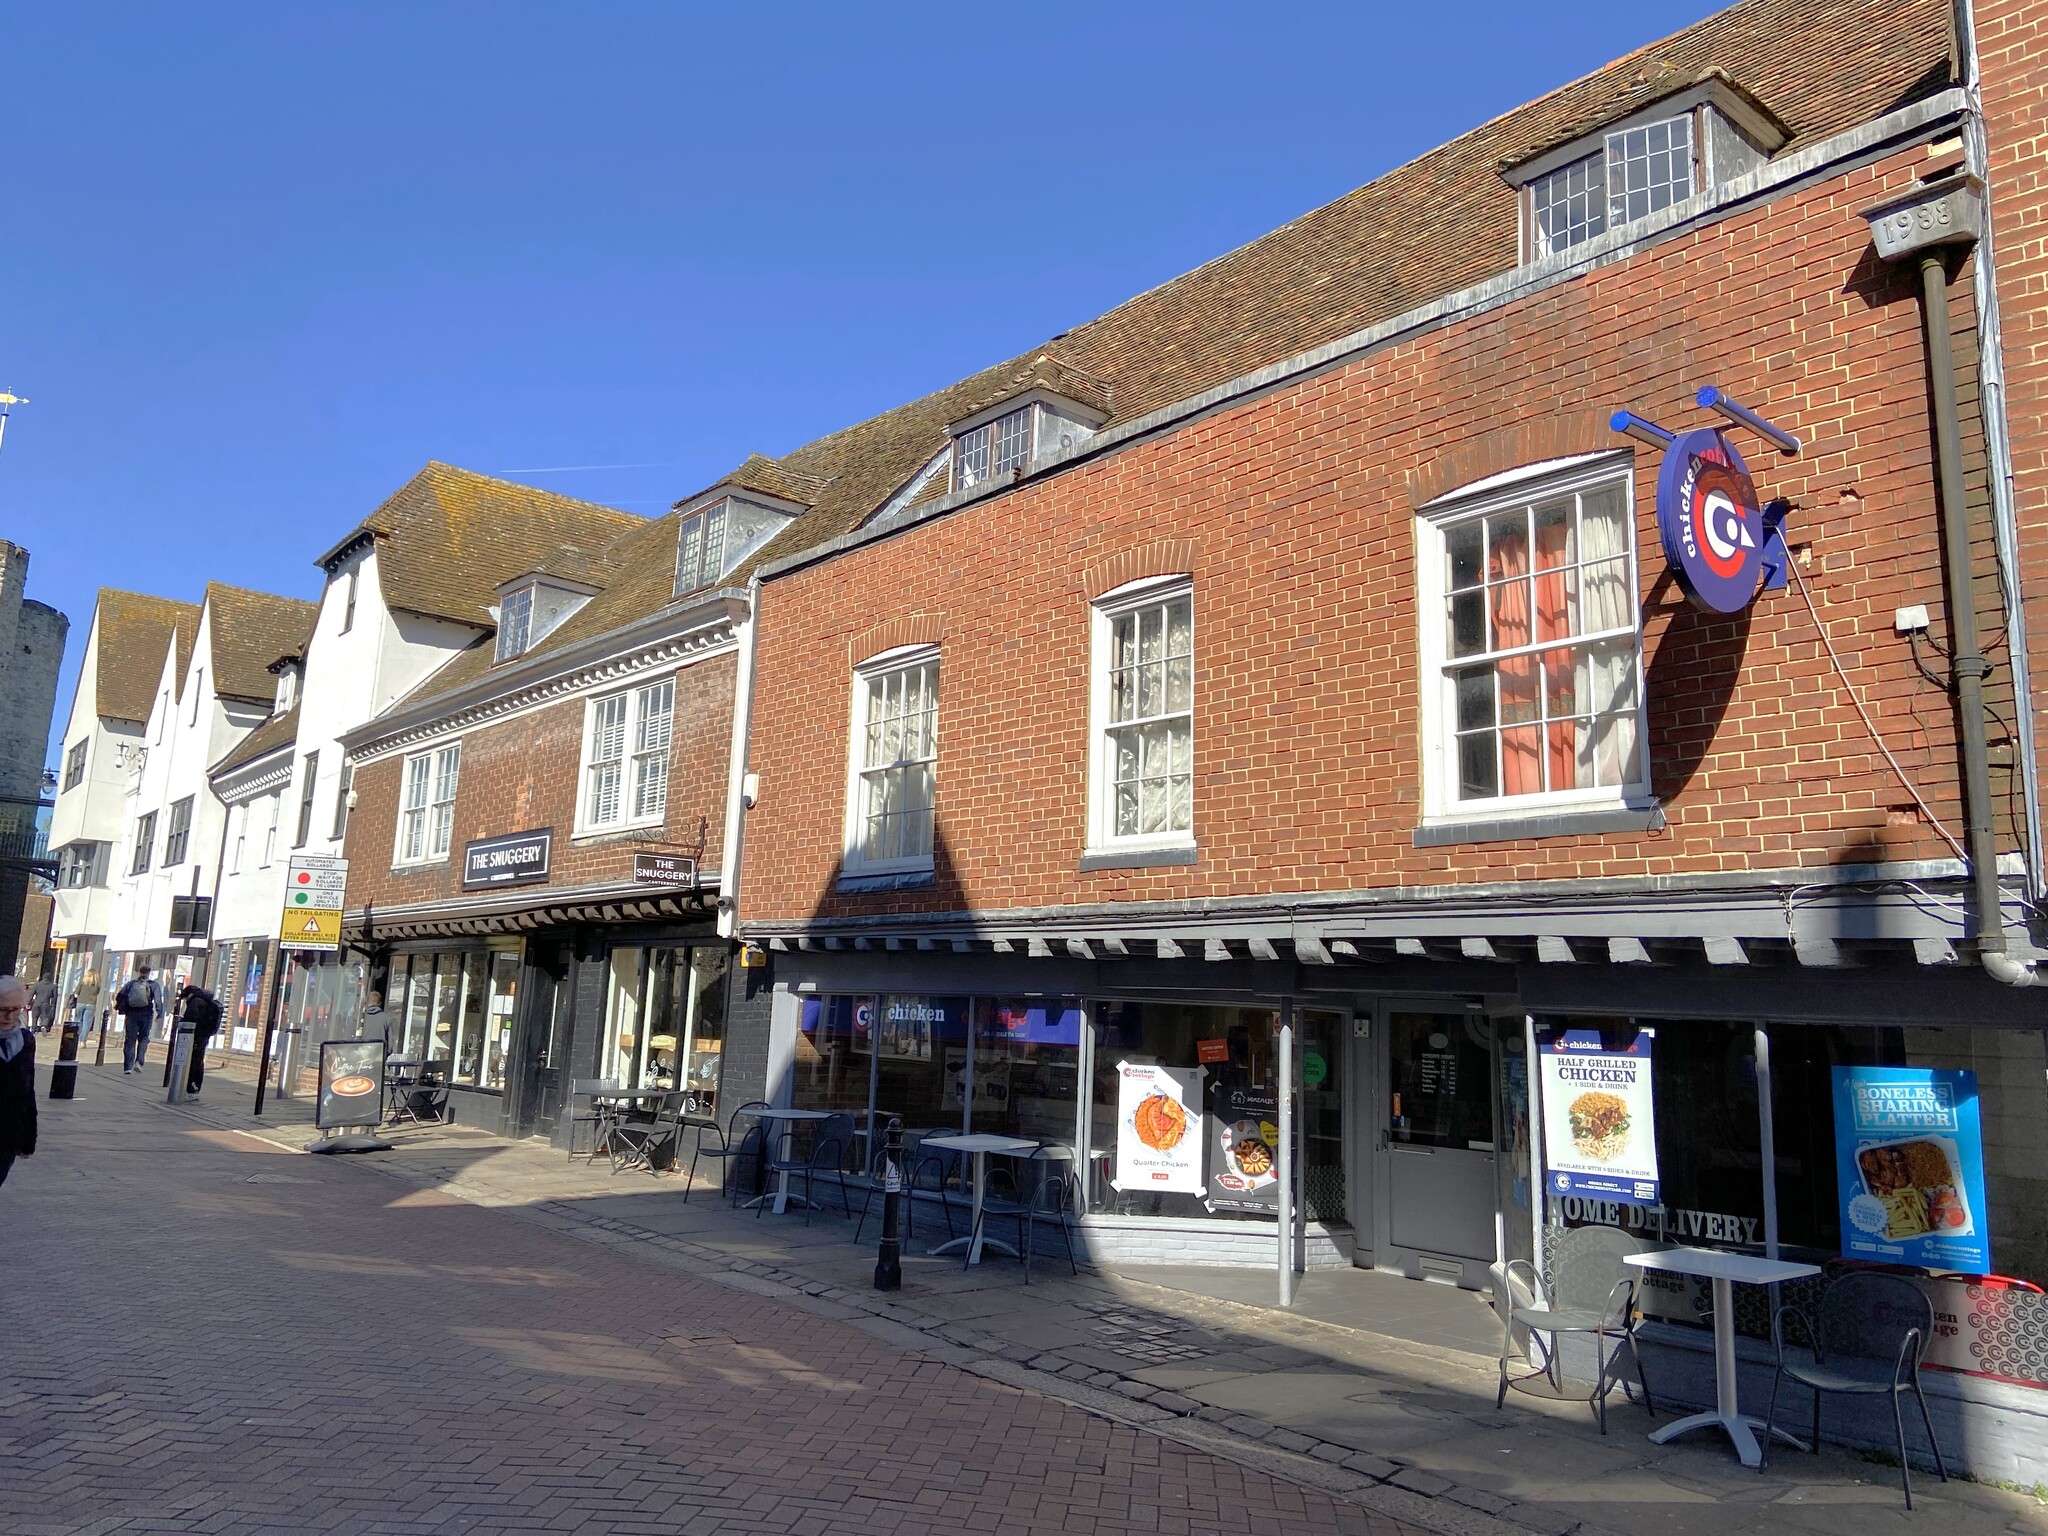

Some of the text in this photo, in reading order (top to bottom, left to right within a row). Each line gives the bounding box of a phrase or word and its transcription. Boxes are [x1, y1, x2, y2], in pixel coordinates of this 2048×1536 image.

[1883, 198, 1953, 244] 1988
[1680, 457, 1703, 558] chicken
[472, 845, 541, 870] THE SNUGGERY
[655, 860, 674, 869] THE
[636, 868, 691, 881] SNUGGERY
[887, 1003, 945, 1022] chicken
[1569, 1041, 1603, 1049] chicken
[1557, 1057, 1637, 1069] HALF GRILLED
[1558, 1067, 1637, 1083] CHICKEN
[1857, 1087, 1948, 1100] BONELESS
[1858, 1100, 1949, 1113] SHARING
[1861, 1113, 1951, 1126] PLATTER
[1133, 1159, 1160, 1167] Quarter
[1631, 1169, 1651, 1177] DRINK
[1626, 1204, 1760, 1244] DELIVERY
[1957, 1246, 1981, 1254] cottage
[1643, 1277, 1685, 1293] ottage
